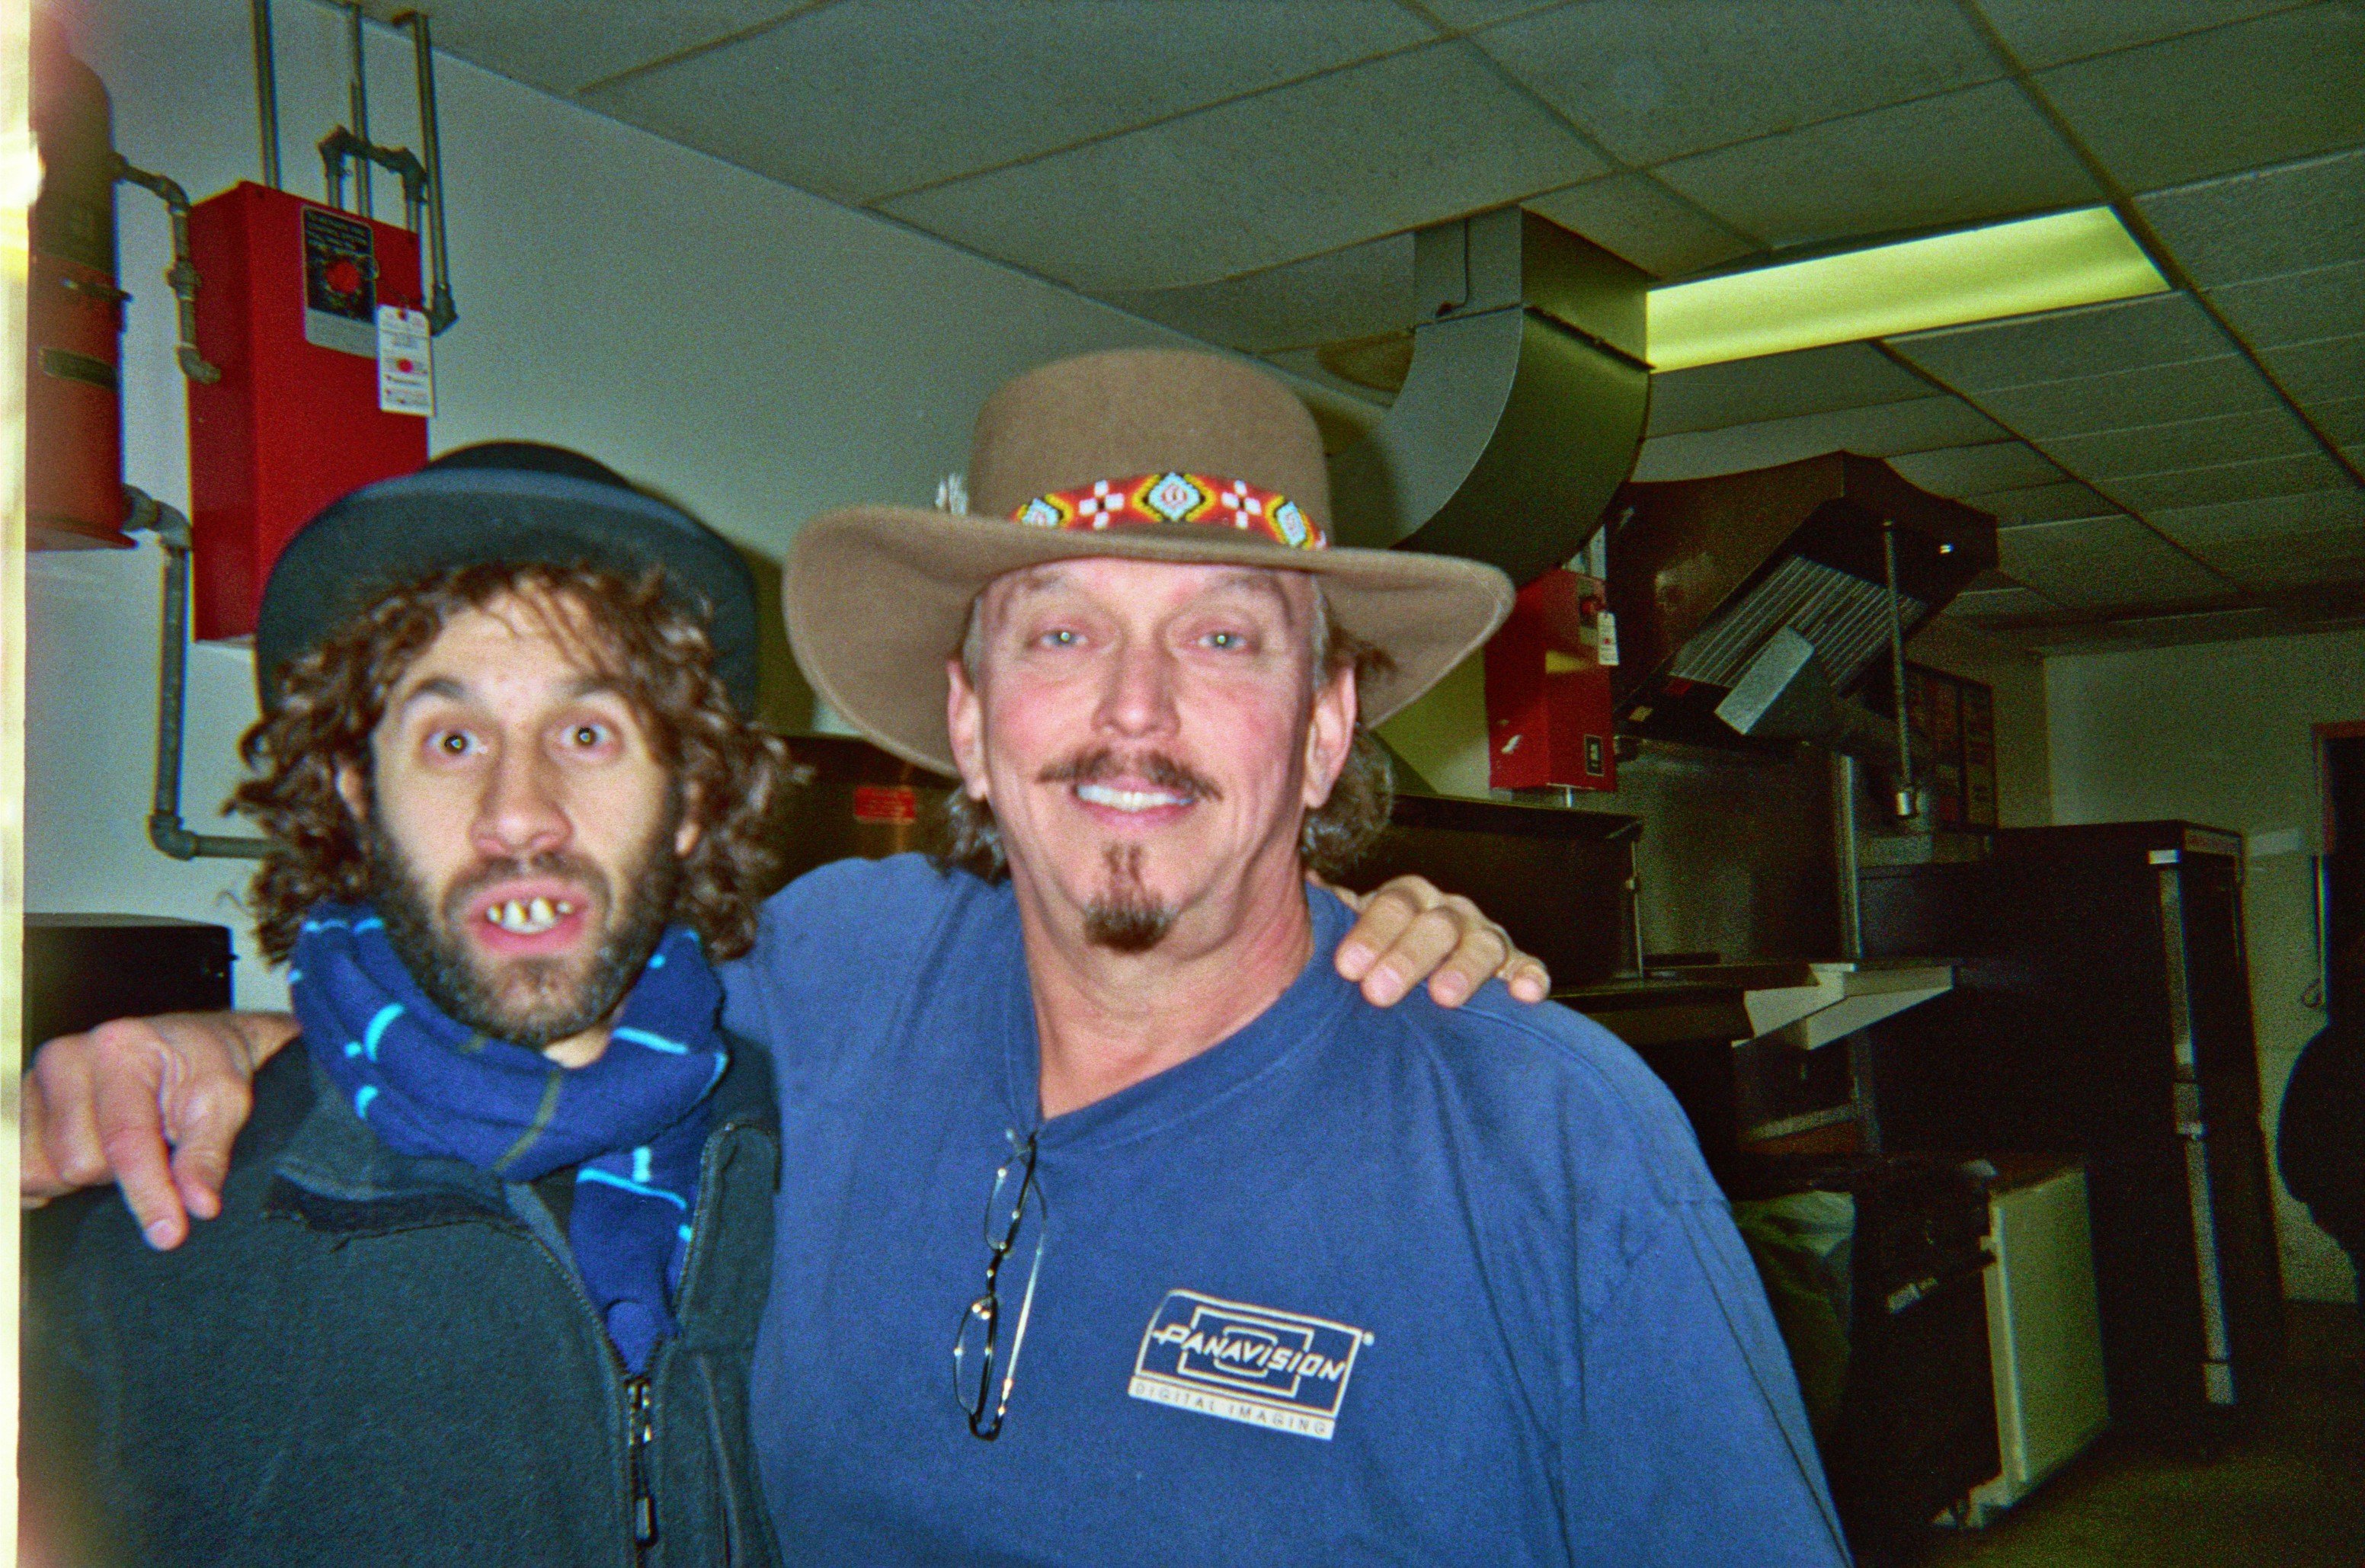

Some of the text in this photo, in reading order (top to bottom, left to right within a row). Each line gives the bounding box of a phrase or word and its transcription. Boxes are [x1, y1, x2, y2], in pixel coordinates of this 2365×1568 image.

[1152, 1323, 1346, 1381] PANAVISION
[1134, 1381, 1327, 1435] DIGITAL IMAGING
